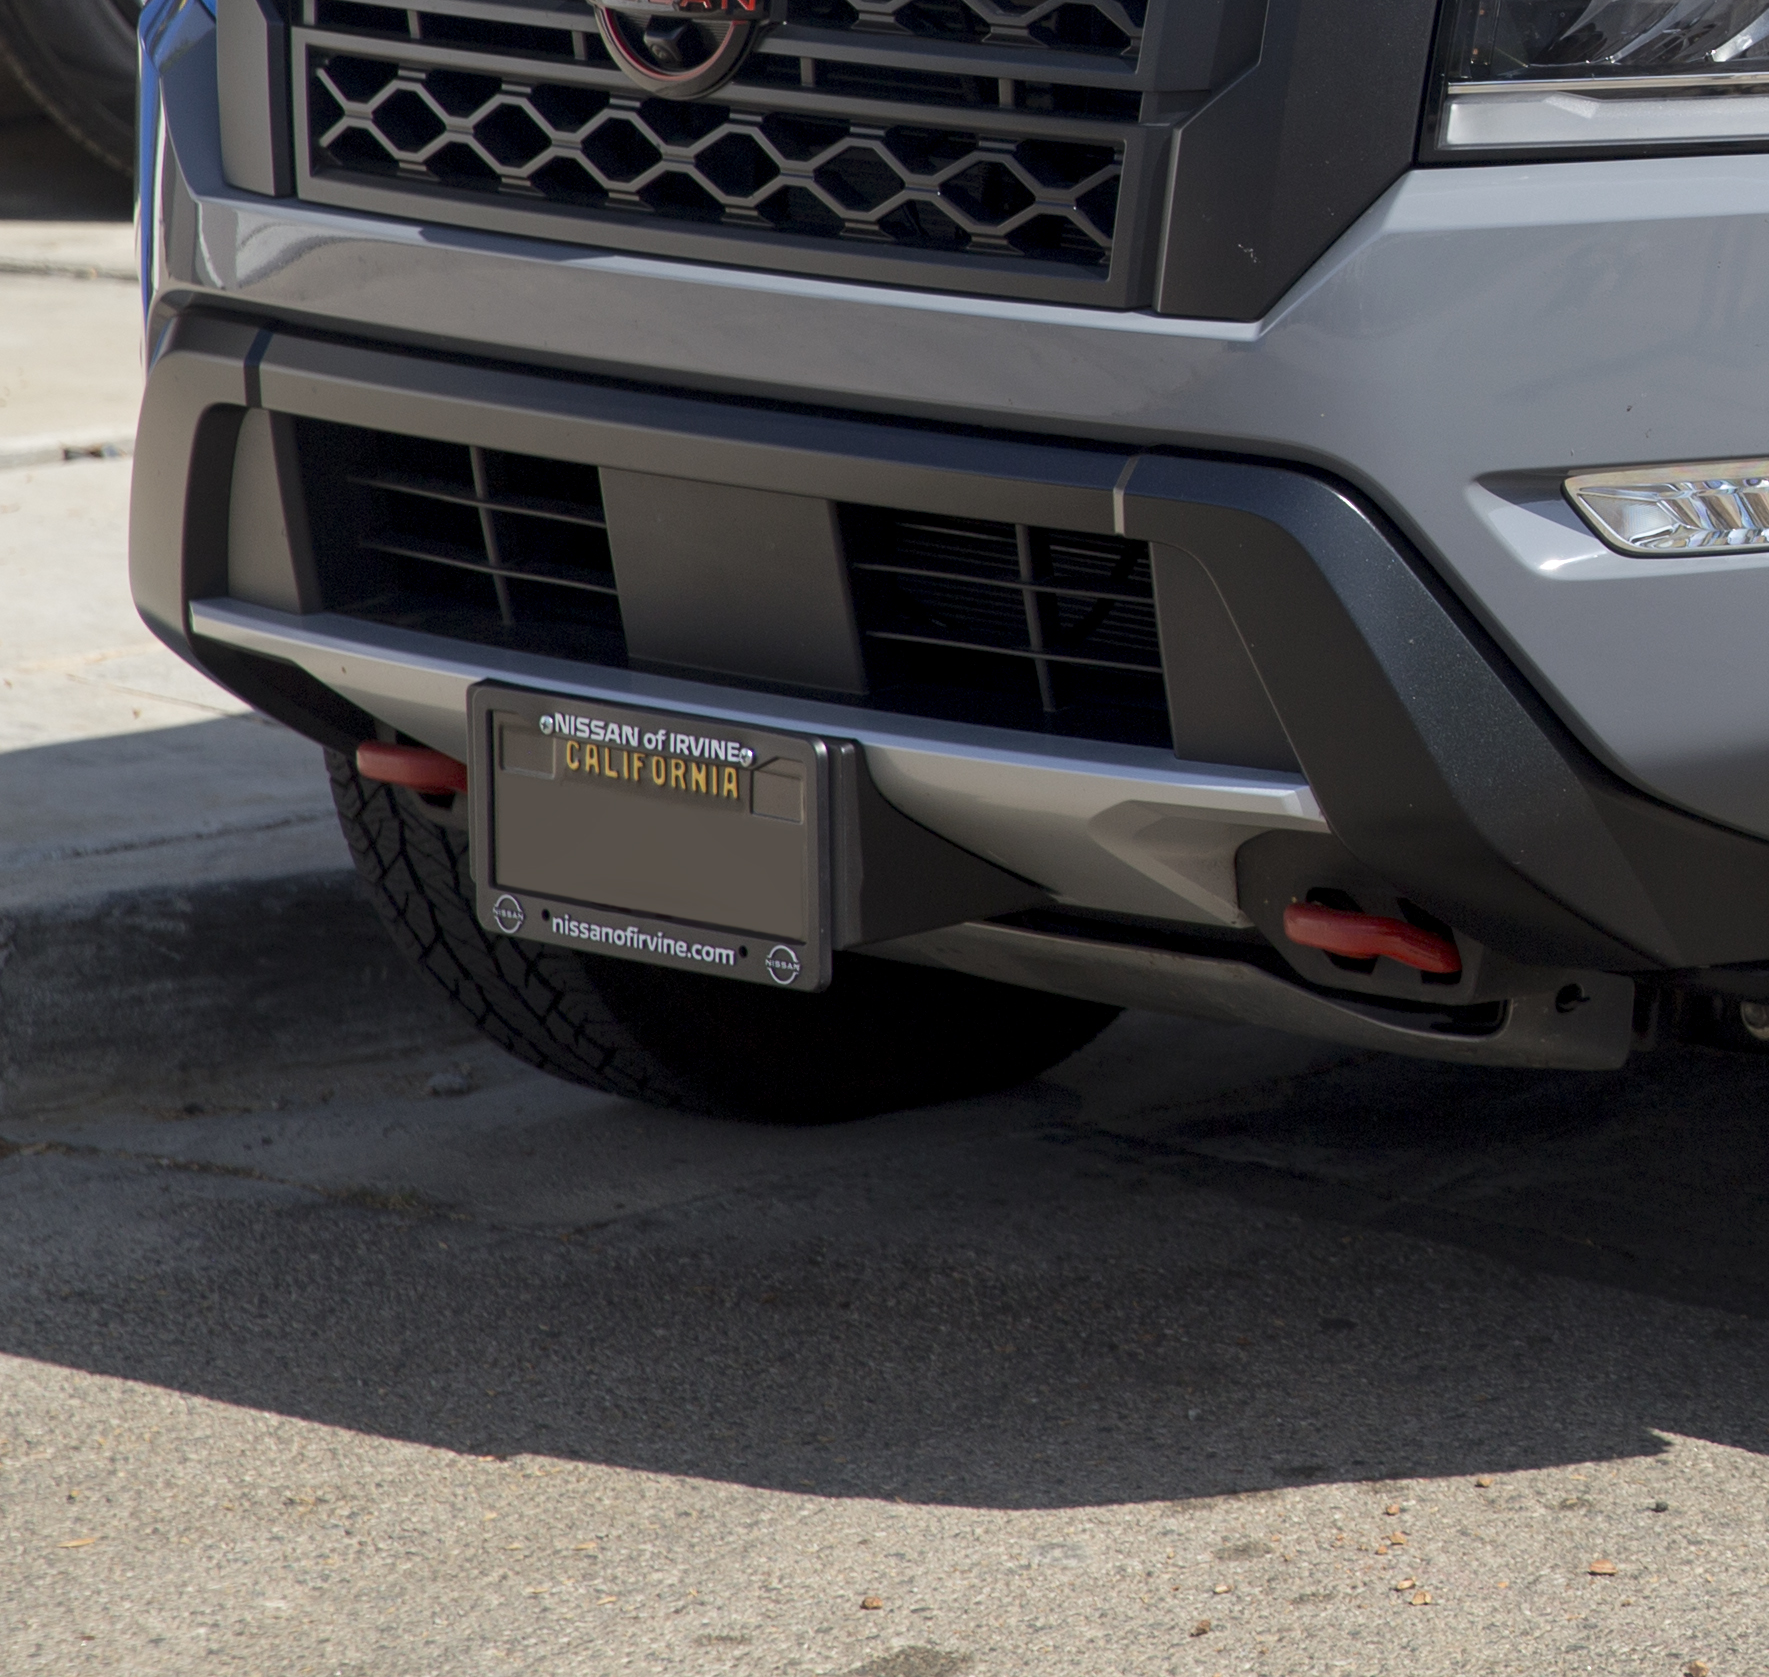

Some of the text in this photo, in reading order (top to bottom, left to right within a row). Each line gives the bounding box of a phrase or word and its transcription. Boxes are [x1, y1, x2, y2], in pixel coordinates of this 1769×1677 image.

[554, 712, 741, 762] NISSAN of IRVINE
[566, 740, 739, 799] CALIFORNIA
[492, 906, 524, 921] NISSAN
[552, 914, 735, 966] nissanofirvine.com
[765, 958, 800, 972] NISSAN
